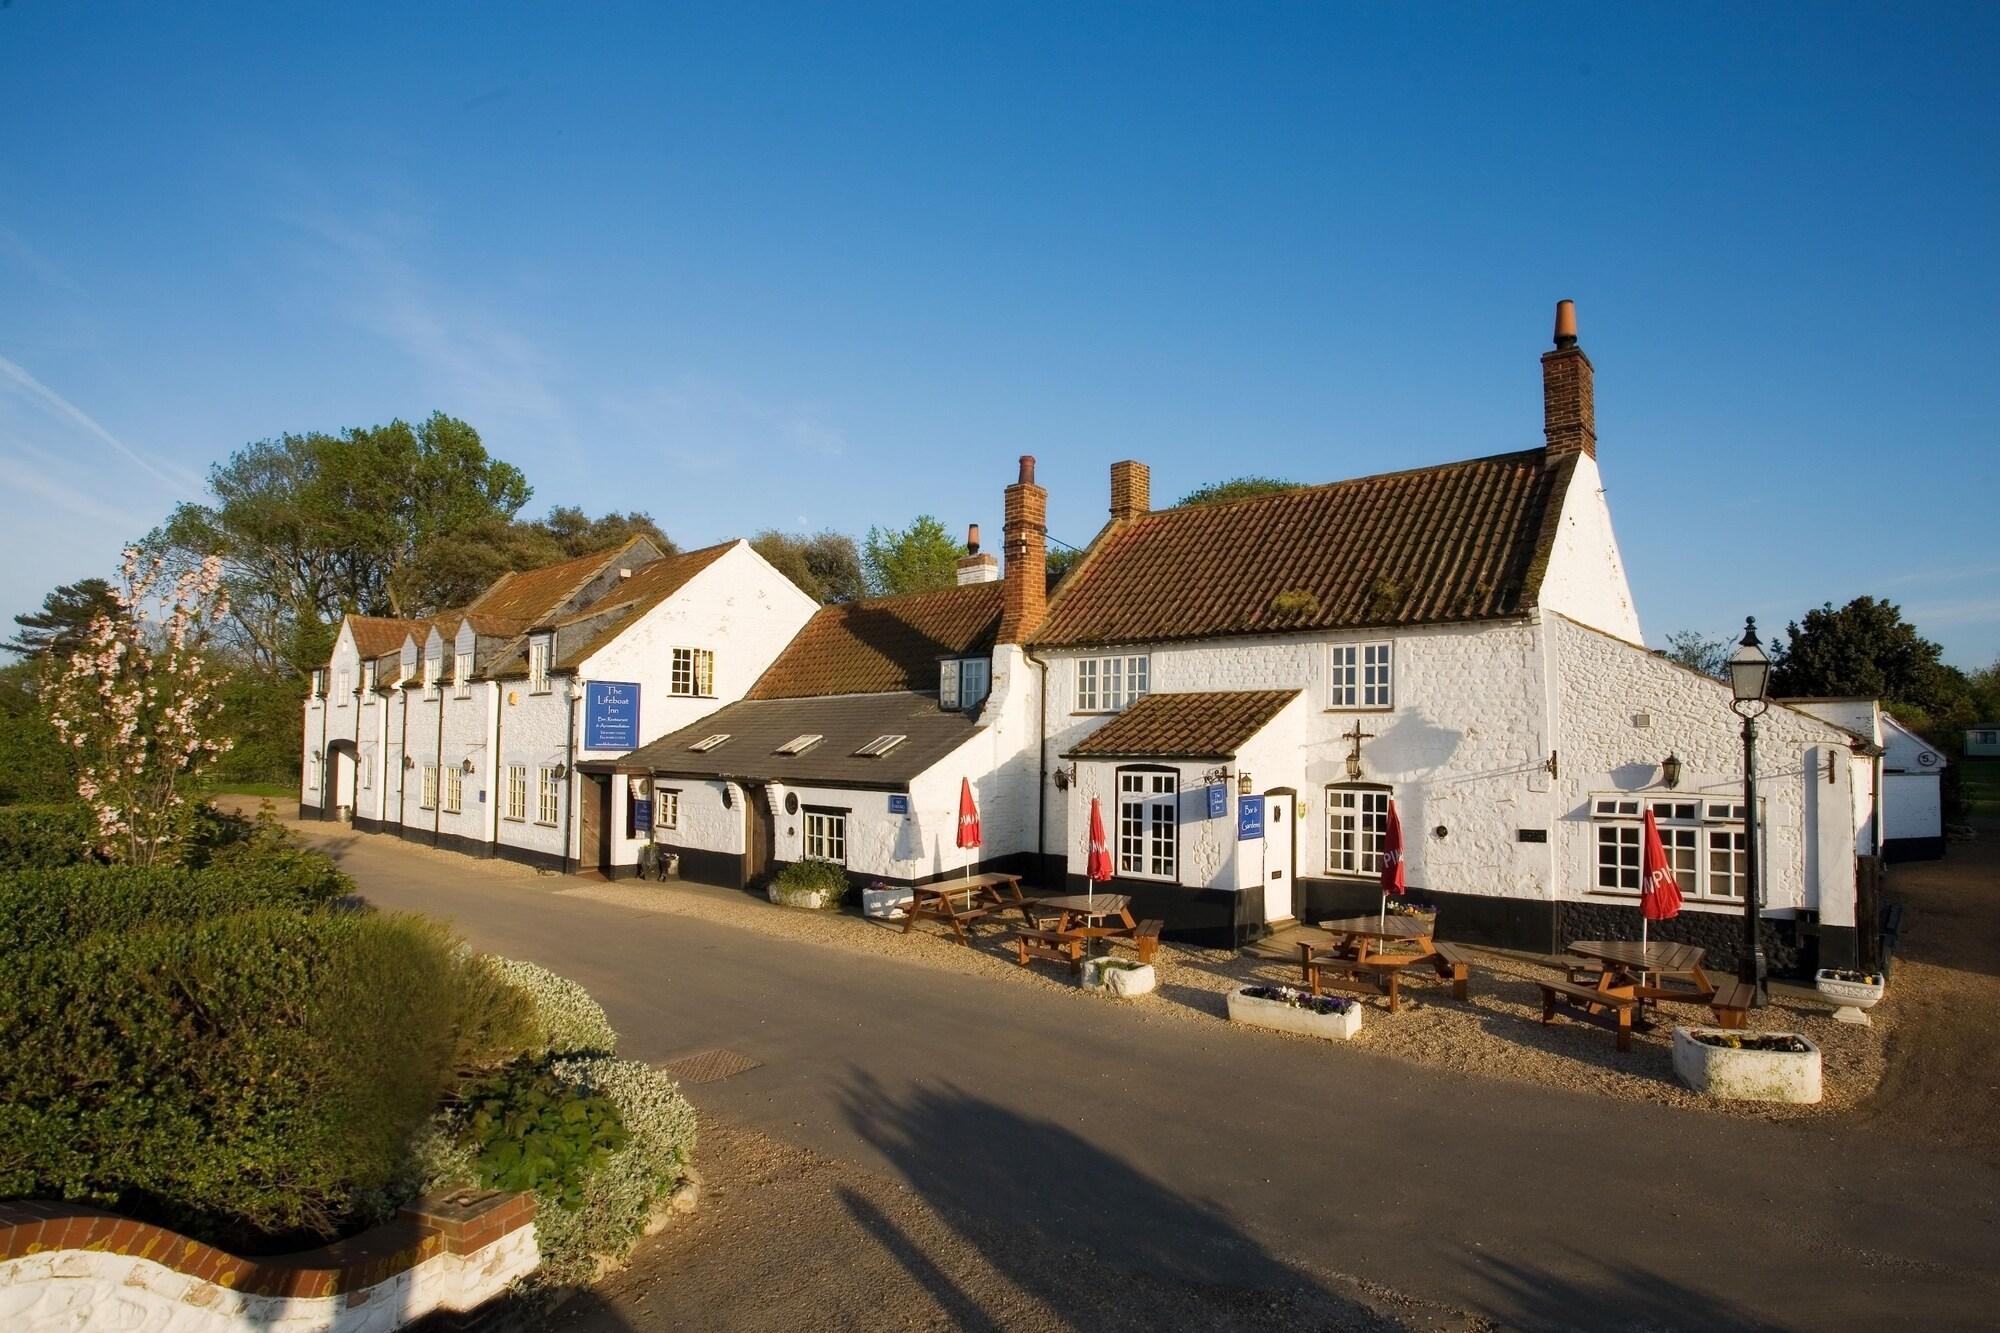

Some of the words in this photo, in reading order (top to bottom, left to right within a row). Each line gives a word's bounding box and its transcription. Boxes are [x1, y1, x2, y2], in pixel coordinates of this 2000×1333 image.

[604, 686, 622, 695] The
[597, 695, 629, 705] Lifeboat
[608, 705, 619, 714] Inn
[1244, 804, 1254, 815] Bar
